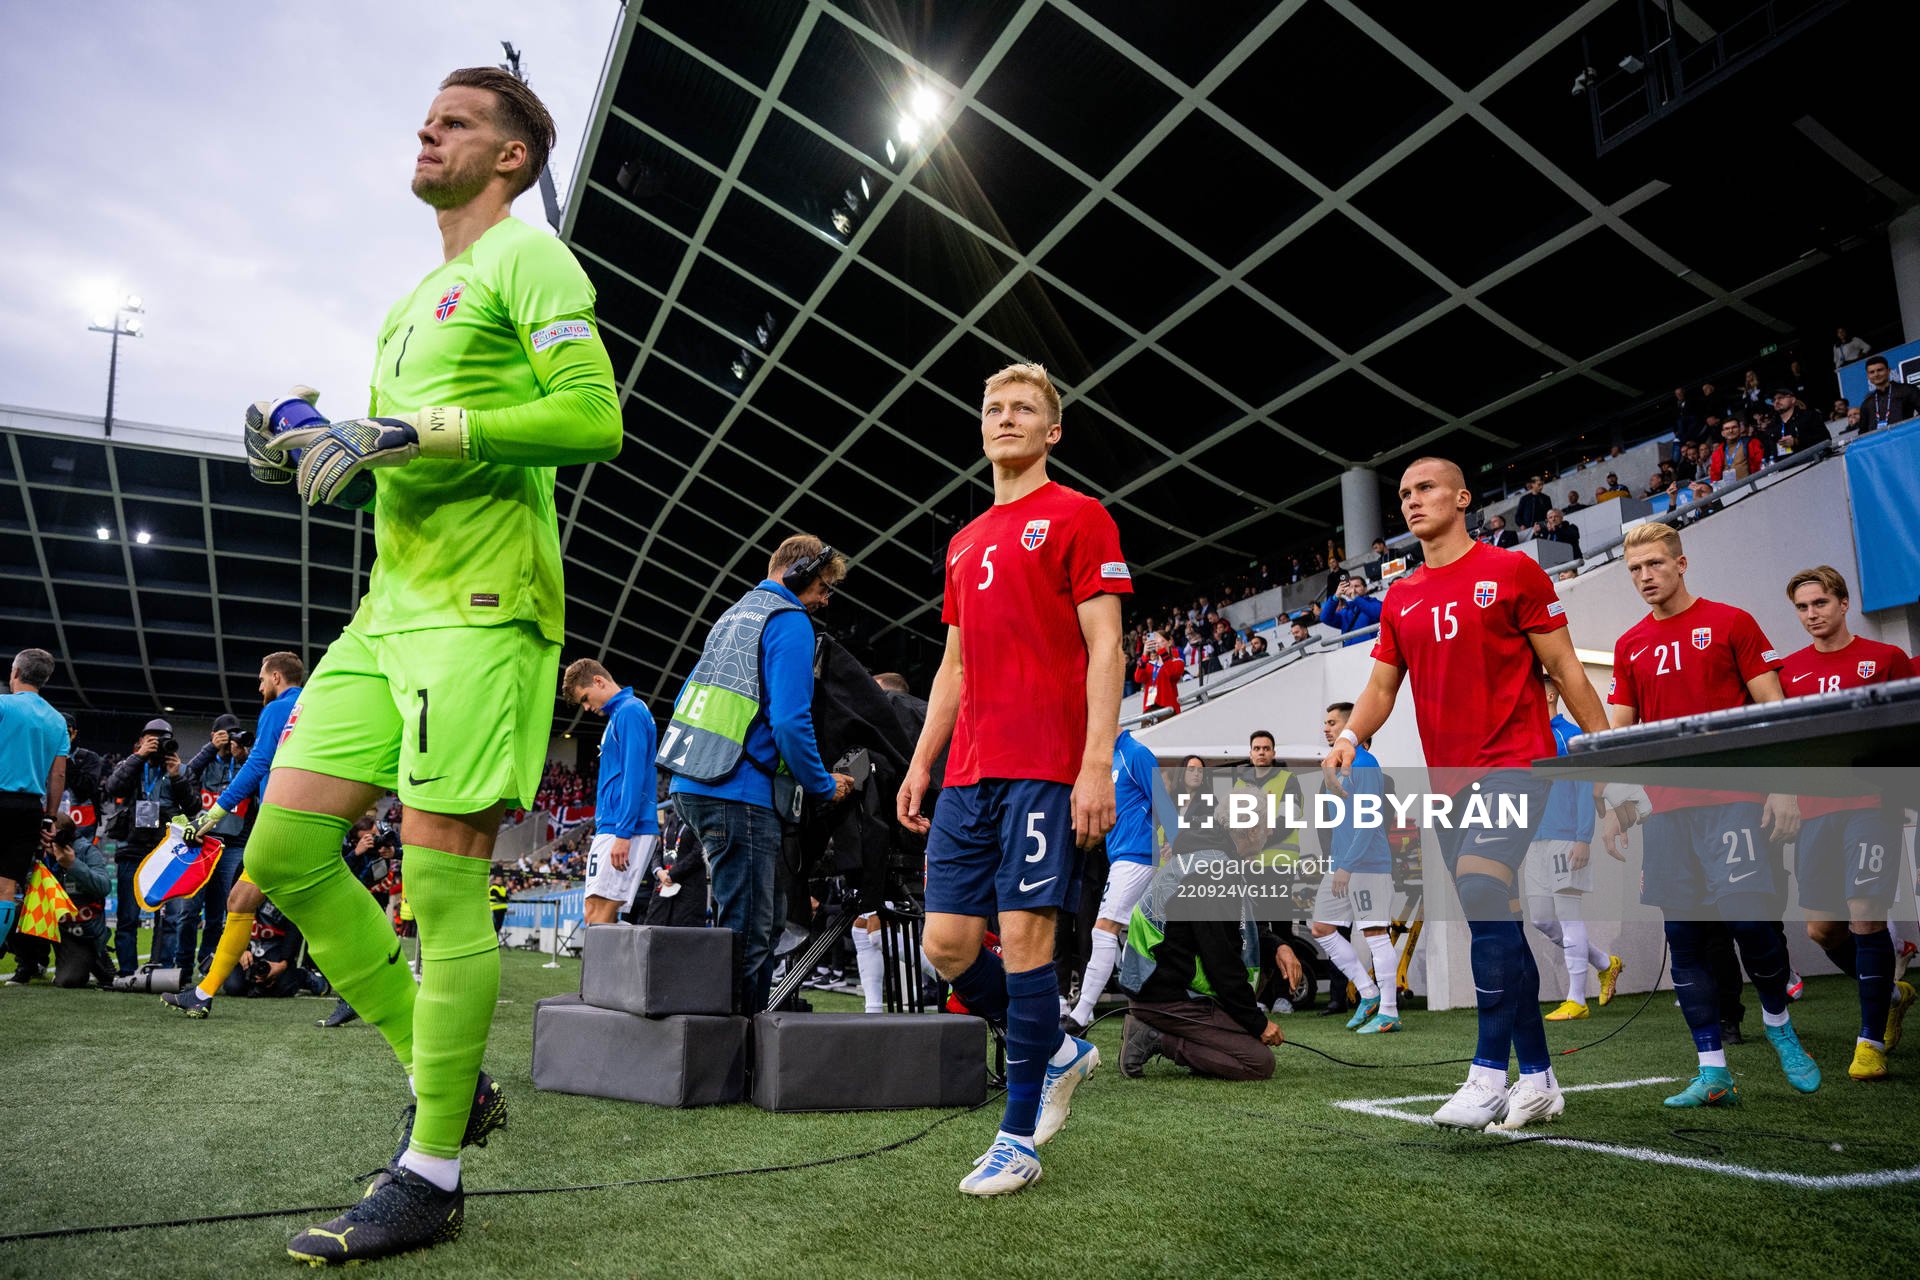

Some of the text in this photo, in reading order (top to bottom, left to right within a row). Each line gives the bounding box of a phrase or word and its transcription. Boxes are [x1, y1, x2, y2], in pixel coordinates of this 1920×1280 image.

[395, 325, 414, 377] 1
[978, 544, 998, 590] 5
[1431, 601, 1458, 642] 15
[1654, 641, 1681, 675] 21
[1818, 675, 1840, 694] 18
[417, 688, 428, 753] 1
[1025, 812, 1047, 863] 5
[1722, 828, 1756, 864] 21
[589, 853, 598, 877] 6
[1553, 853, 1569, 874] 11
[1858, 842, 1885, 873] 18
[1353, 889, 1373, 912] 18
